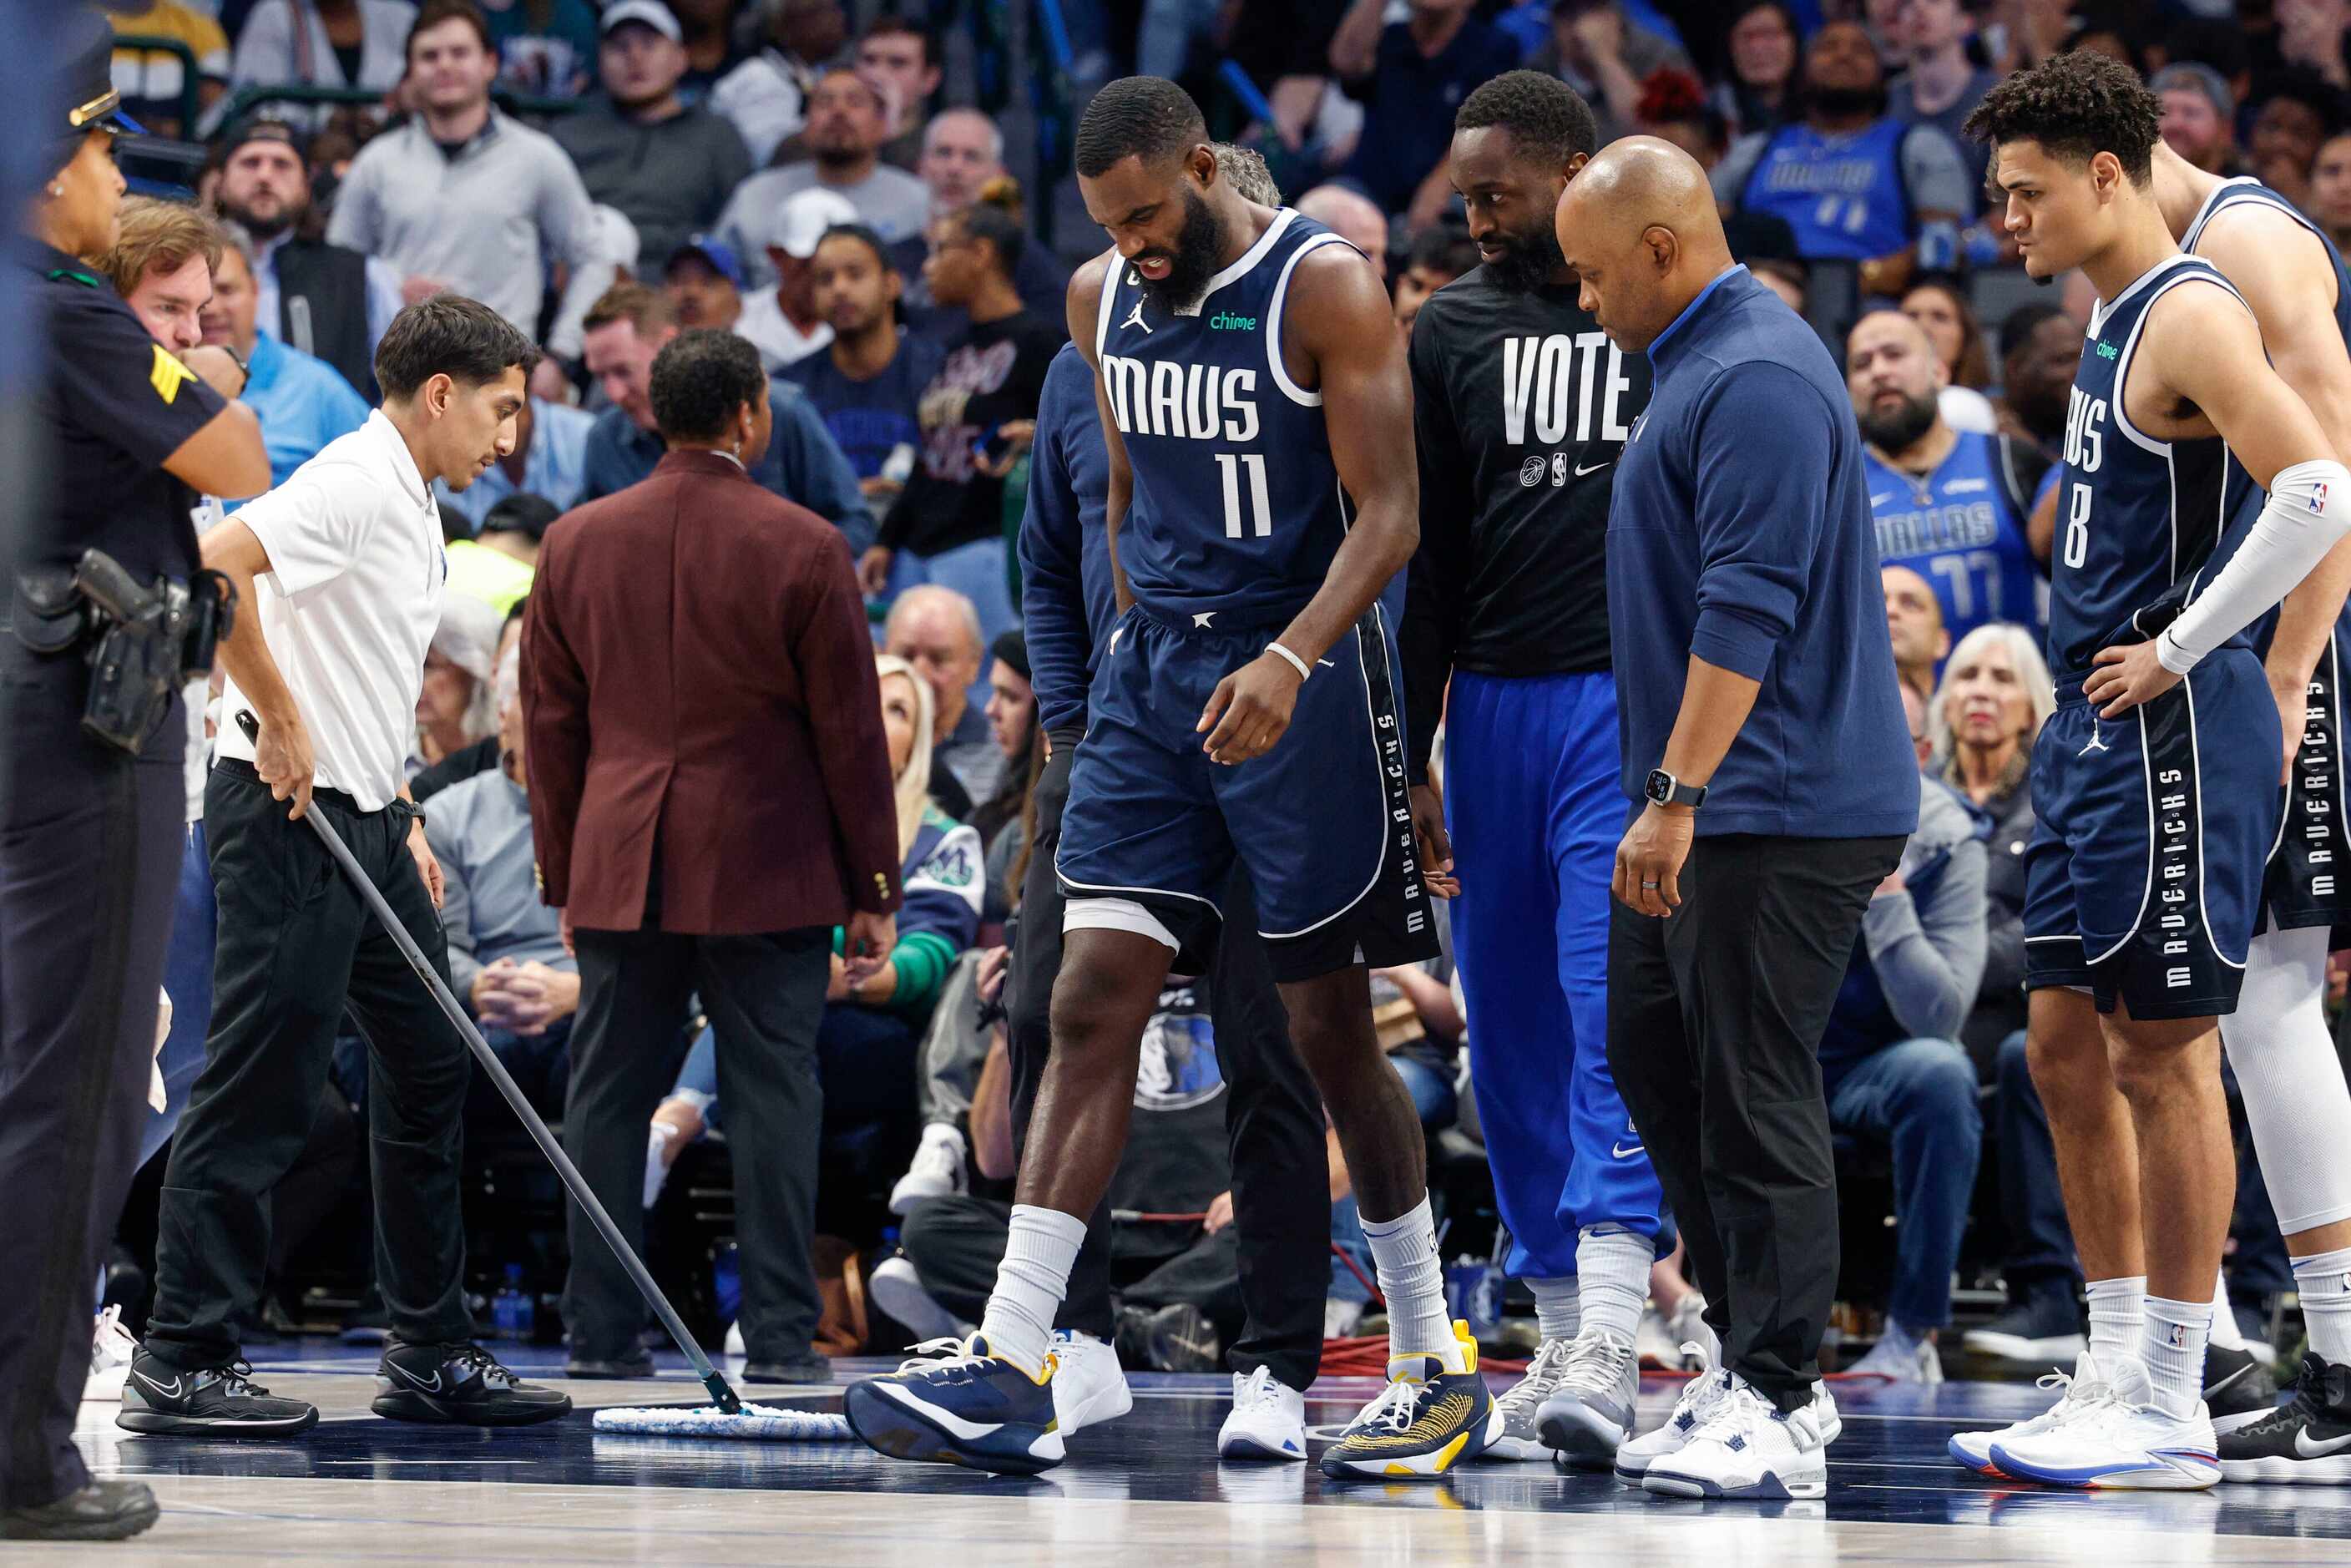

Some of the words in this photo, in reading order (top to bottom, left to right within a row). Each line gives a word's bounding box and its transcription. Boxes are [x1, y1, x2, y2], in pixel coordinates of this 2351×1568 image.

[1211, 311, 1256, 331] chime
[2096, 339, 2118, 360] chime
[1102, 354, 1260, 442] MAVS
[1504, 331, 1630, 445] VOTE
[2063, 383, 2107, 473] AVS
[1214, 453, 1272, 539] 11
[2064, 483, 2092, 569] 8
[1930, 550, 2005, 622] 77
[1378, 714, 1425, 933] MAVERICKS
[2303, 682, 2336, 896] MAVERICKS
[2159, 769, 2192, 988] MAVERICKS
